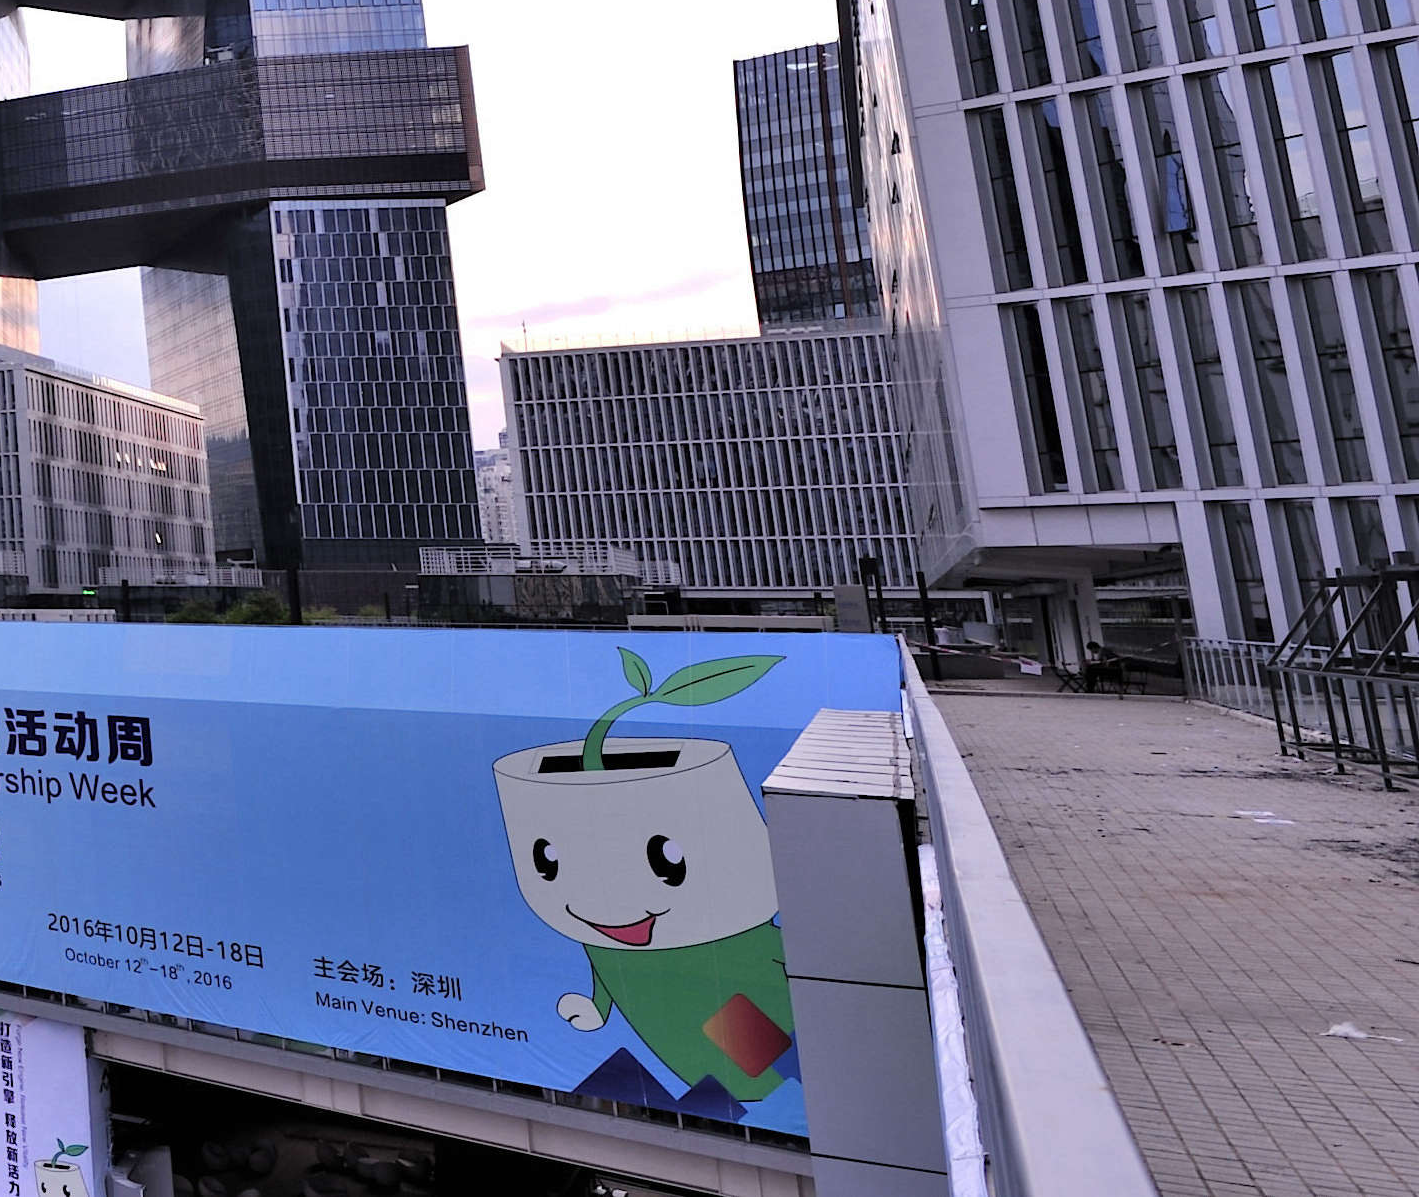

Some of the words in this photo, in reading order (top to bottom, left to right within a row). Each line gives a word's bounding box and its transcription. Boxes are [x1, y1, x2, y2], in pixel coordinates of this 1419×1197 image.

[68, 771, 156, 807] Week
[47, 912, 264, 969] 2016年10月12日-18日
[64, 948, 120, 971] October
[315, 991, 357, 1013] Main
[362, 1000, 426, 1027] Venue:
[431, 1011, 529, 1043] Shenzhen
